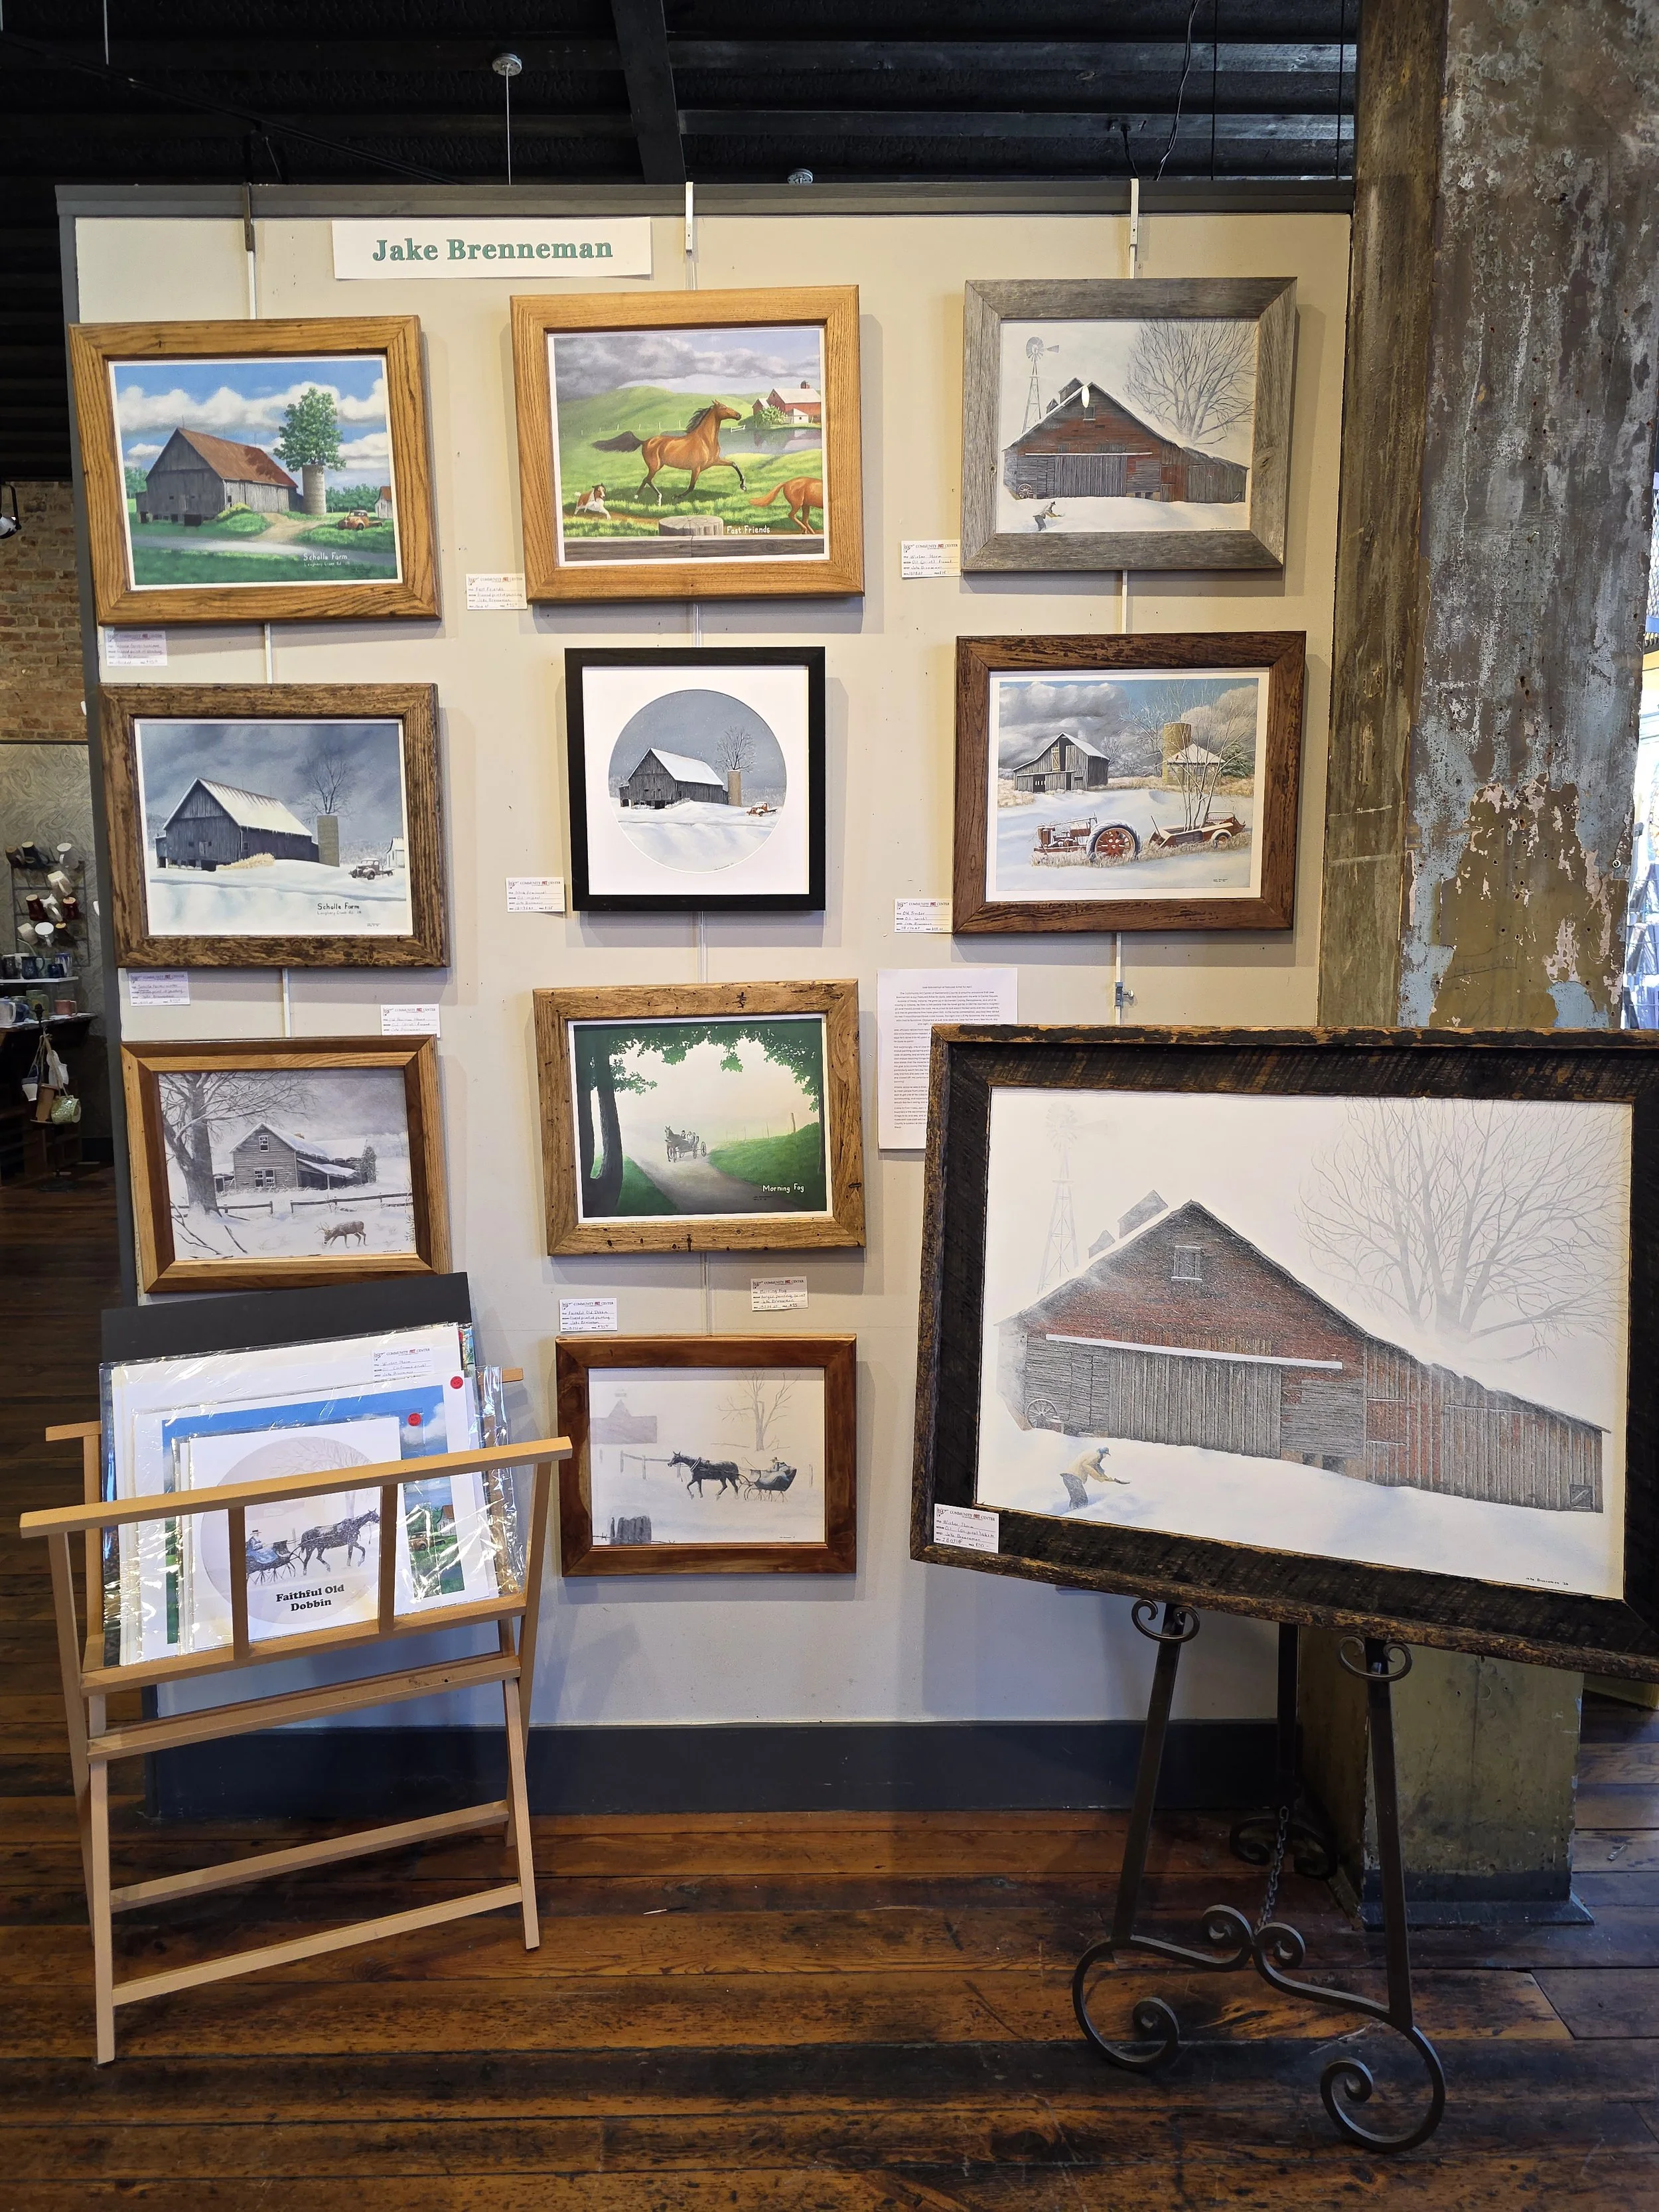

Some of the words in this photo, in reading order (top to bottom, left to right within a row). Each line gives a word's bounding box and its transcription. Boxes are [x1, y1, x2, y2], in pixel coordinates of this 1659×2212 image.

[372, 238, 438, 261] Jake
[447, 239, 613, 260] Brenneman
[727, 526, 741, 534] Fast
[744, 524, 770, 534] Friends
[331, 552, 348, 560] Farm
[762, 1184, 790, 1193] Morning
[794, 1183, 804, 1193] Fog
[276, 1587, 323, 1602] Faithful
[325, 1584, 344, 1593] Old
[291, 1599, 332, 1611] Dobbin
